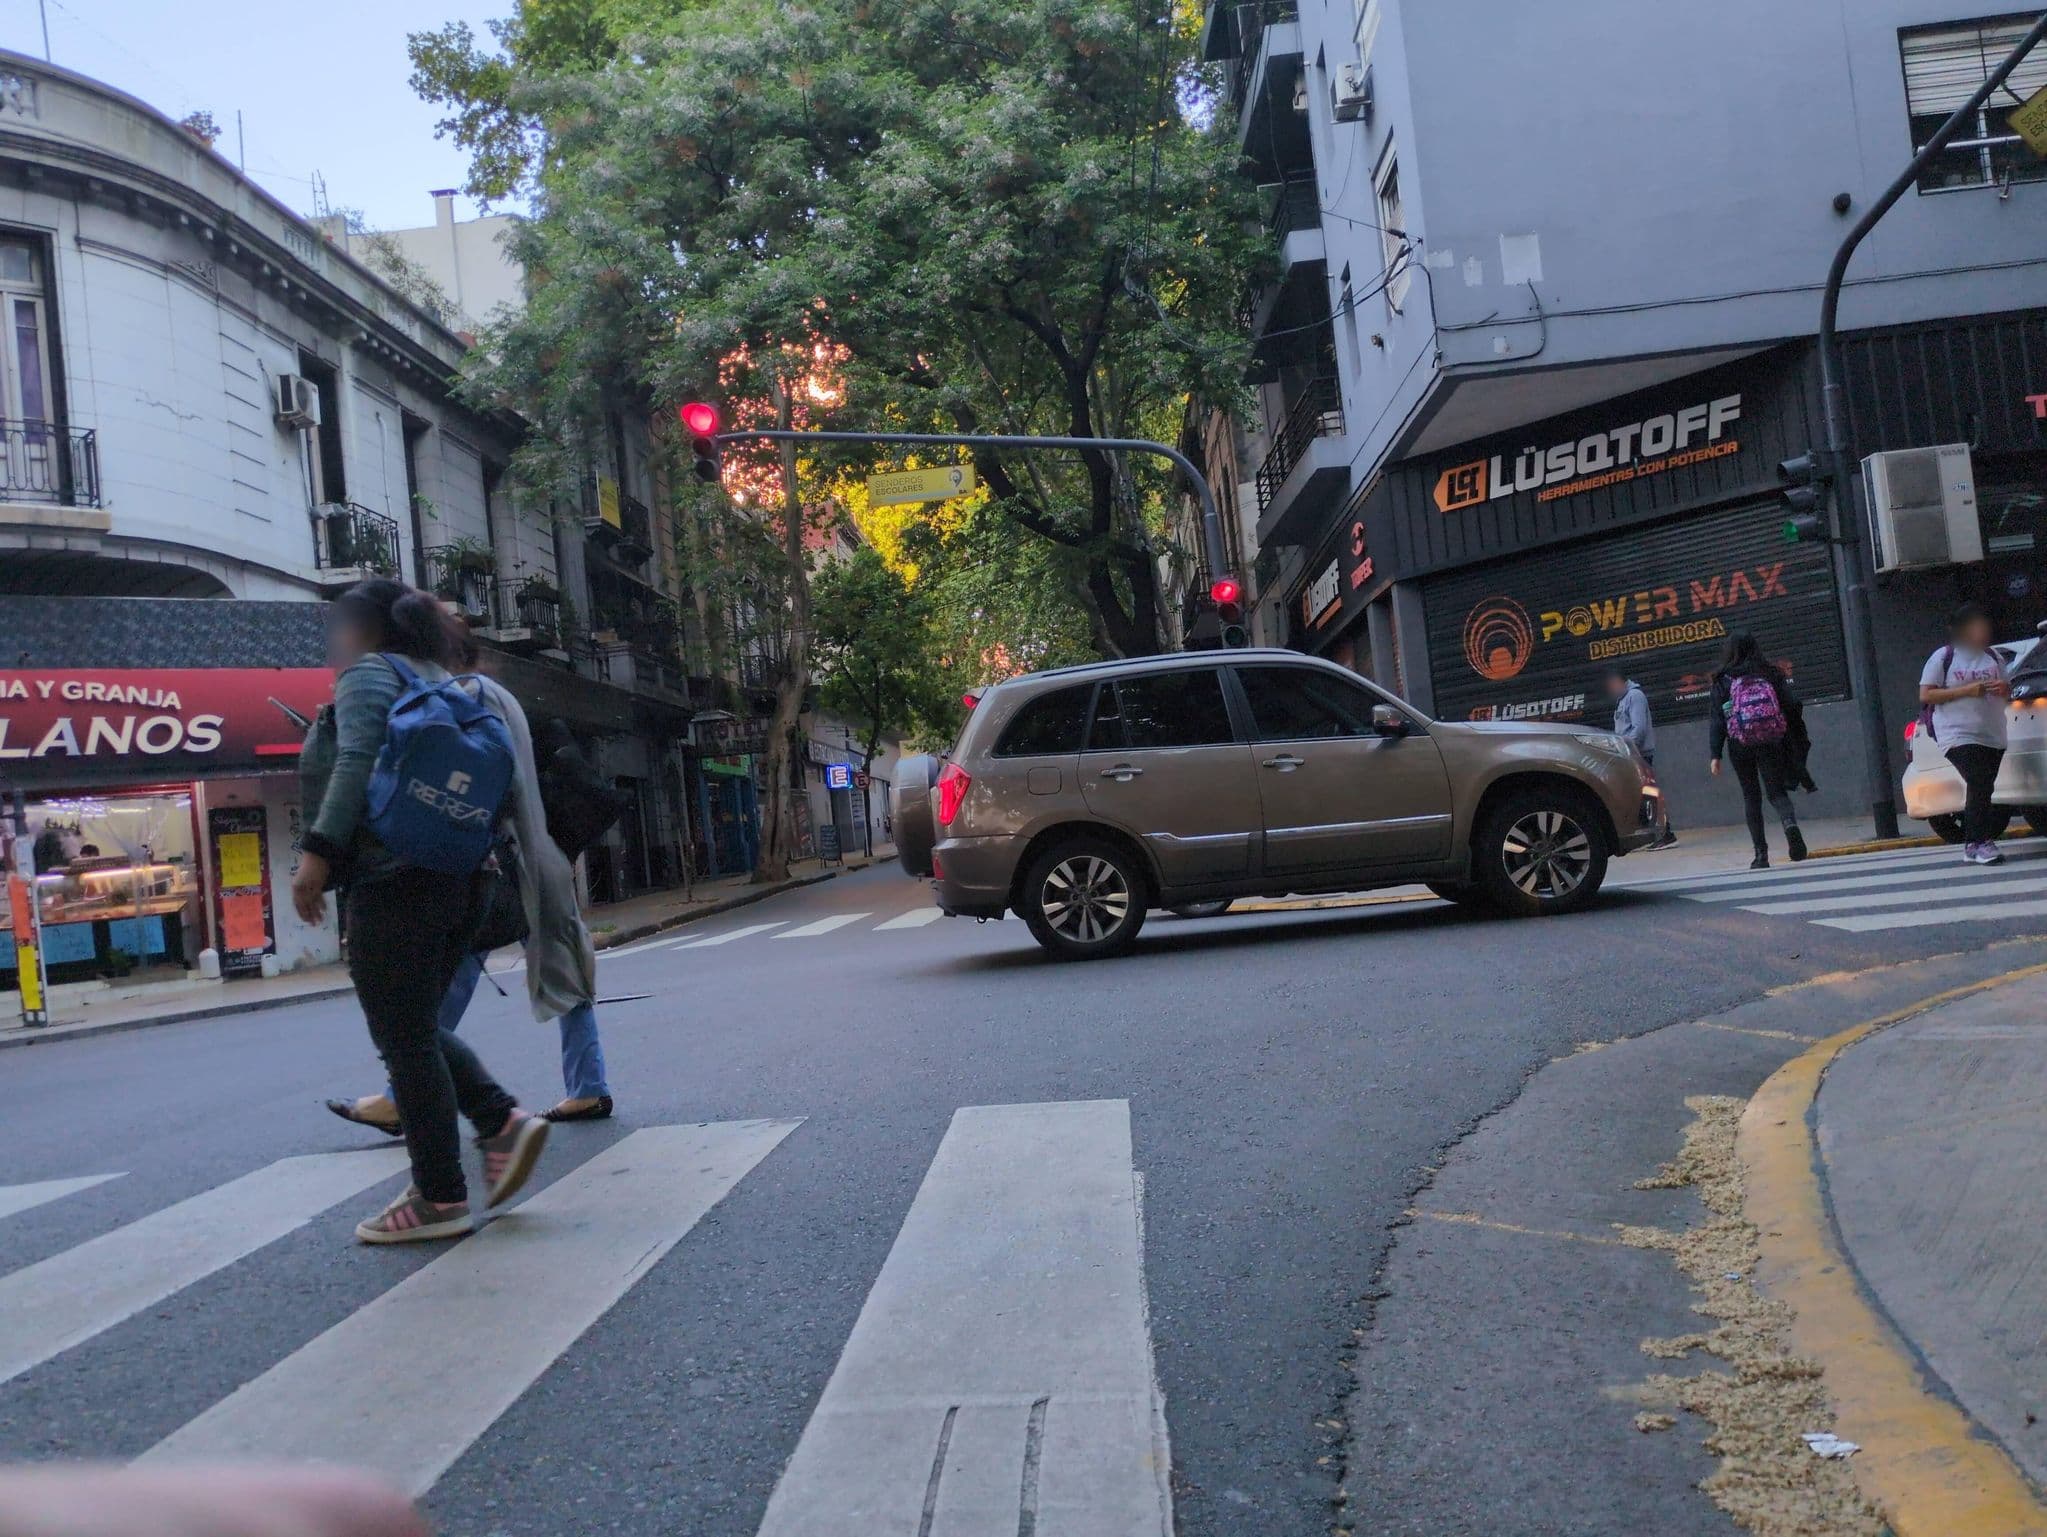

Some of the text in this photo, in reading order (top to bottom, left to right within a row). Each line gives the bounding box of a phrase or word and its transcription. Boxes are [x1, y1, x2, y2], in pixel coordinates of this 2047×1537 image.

[875, 476, 923, 489] SENDEROS
[876, 484, 924, 496] ESCOLARES
[1537, 440, 1739, 502] HERRAMIENTAS CON POTENCIA
[1540, 562, 1788, 642] POWER MAX
[1590, 616, 1726, 660] DISTRIBUIDORA
[35, 679, 55, 699] Y
[61, 680, 182, 710] GRANJA
[0, 714, 224, 759] LANOS
